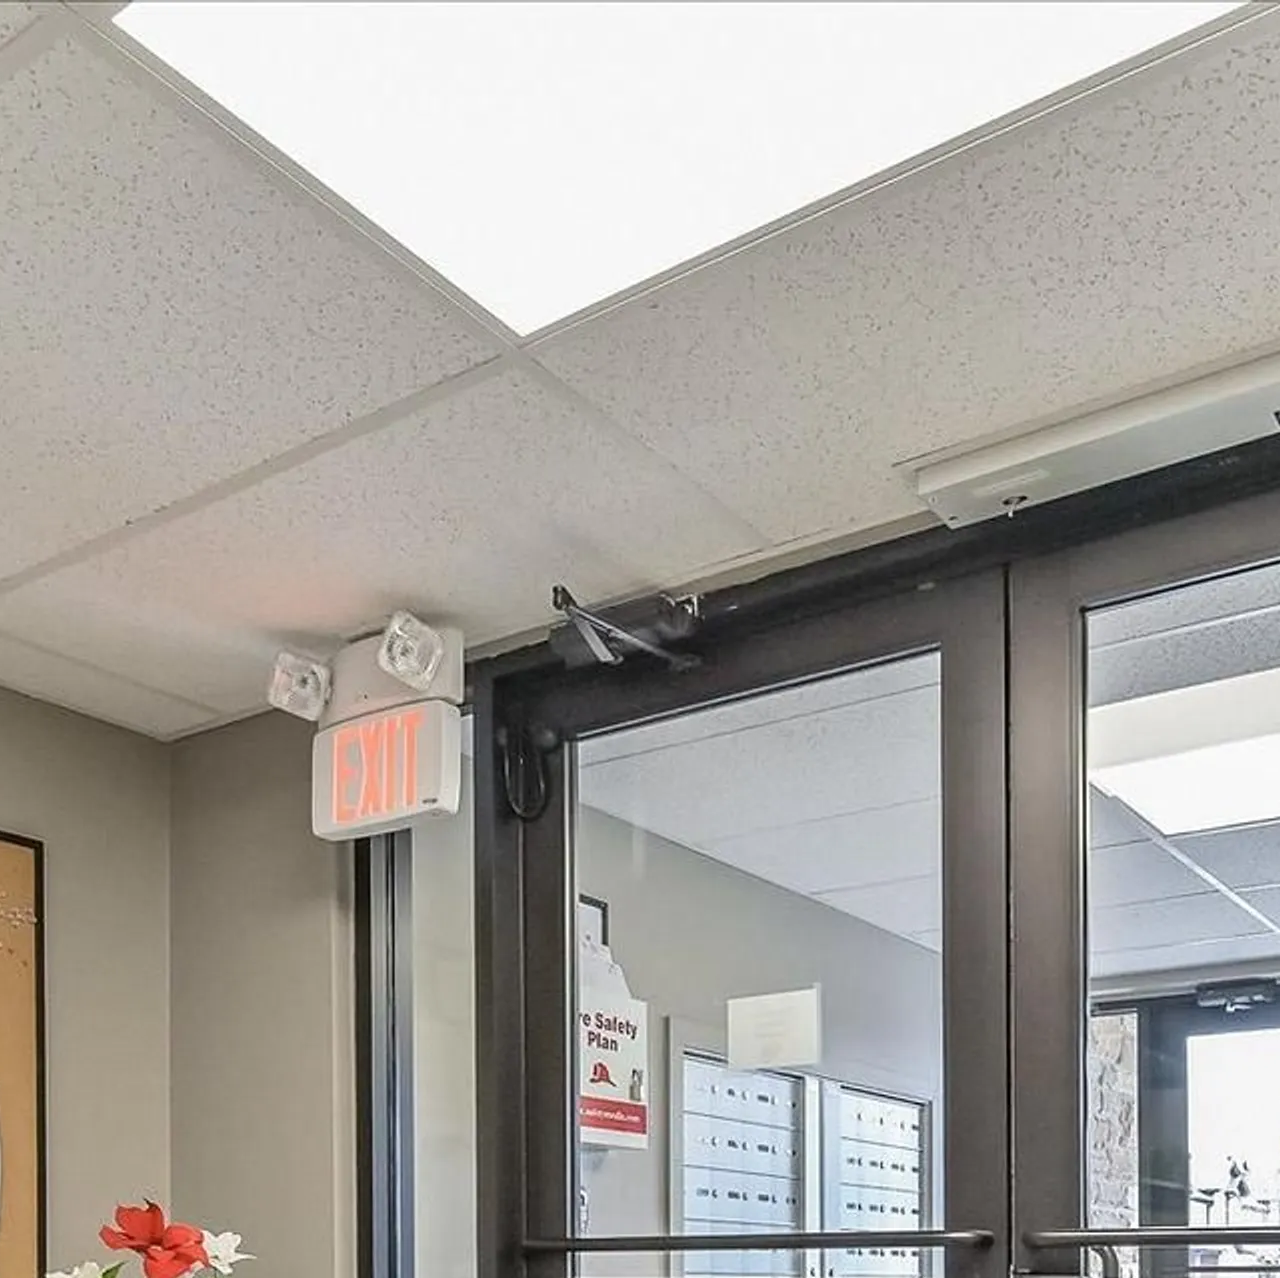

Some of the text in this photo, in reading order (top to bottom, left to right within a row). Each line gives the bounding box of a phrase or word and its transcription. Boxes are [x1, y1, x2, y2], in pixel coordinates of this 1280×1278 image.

[333, 709, 423, 823] EXIT
[594, 1012, 638, 1040] Safety
[587, 1030, 619, 1052] Plan
